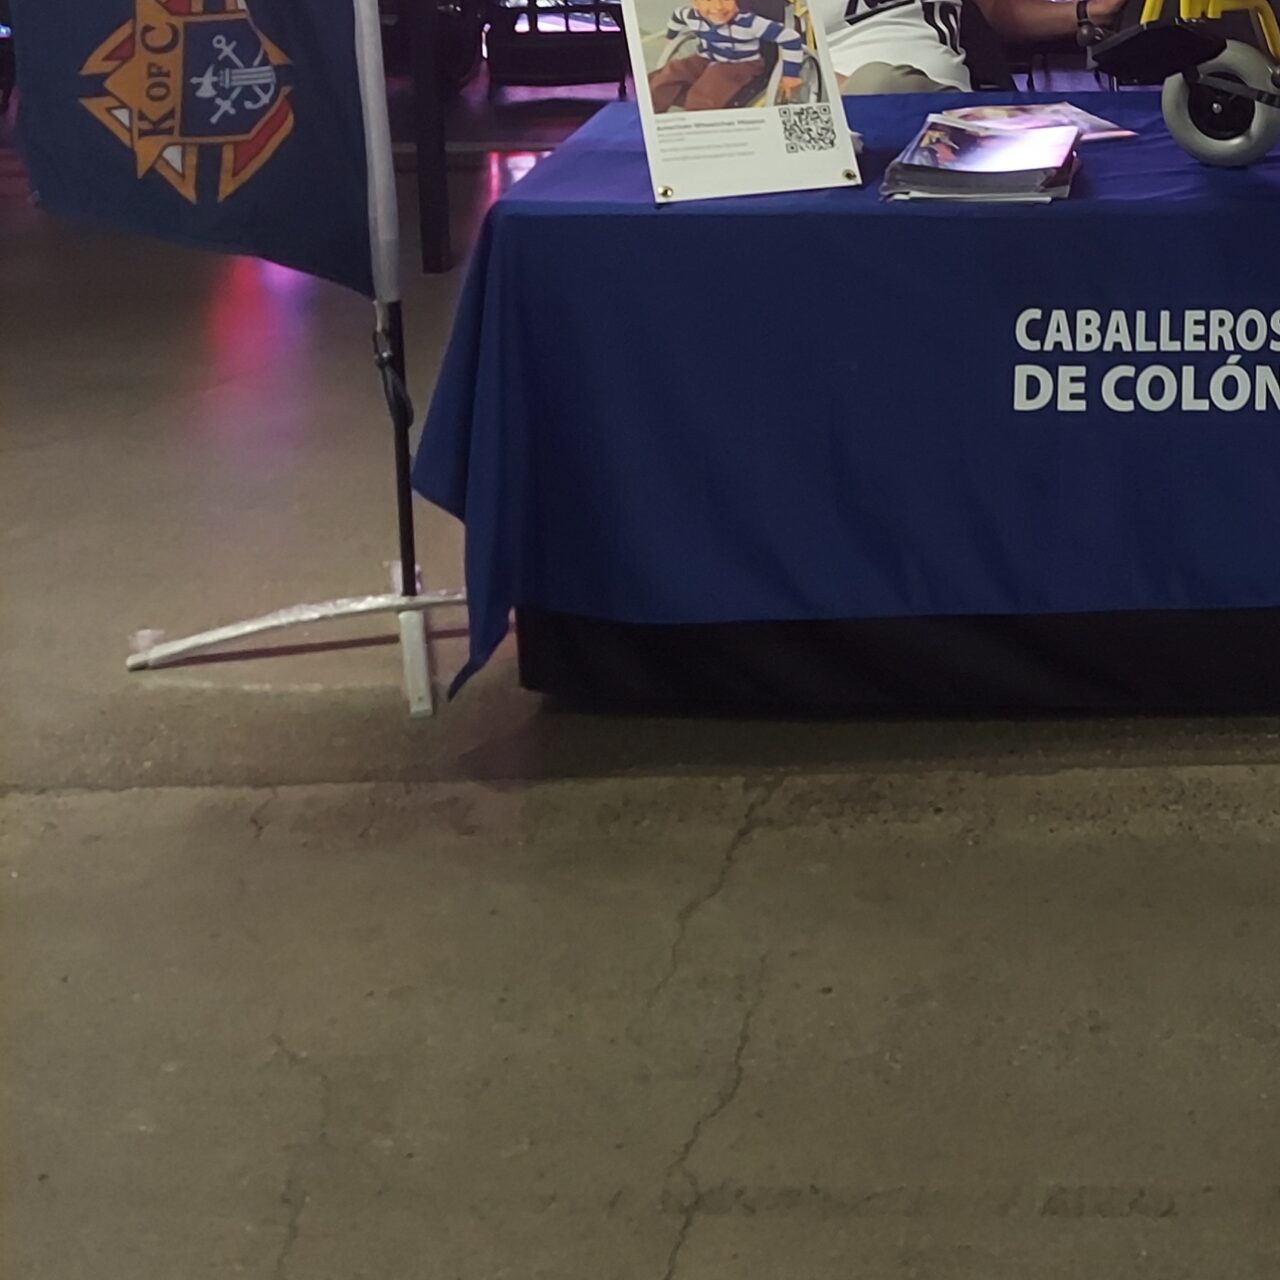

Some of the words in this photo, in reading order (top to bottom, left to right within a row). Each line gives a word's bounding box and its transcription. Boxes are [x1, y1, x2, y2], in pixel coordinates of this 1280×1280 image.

[141, 22, 179, 54] C
[146, 62, 171, 102] OF
[138, 107, 175, 140] K
[1013, 364, 1087, 411] DE
